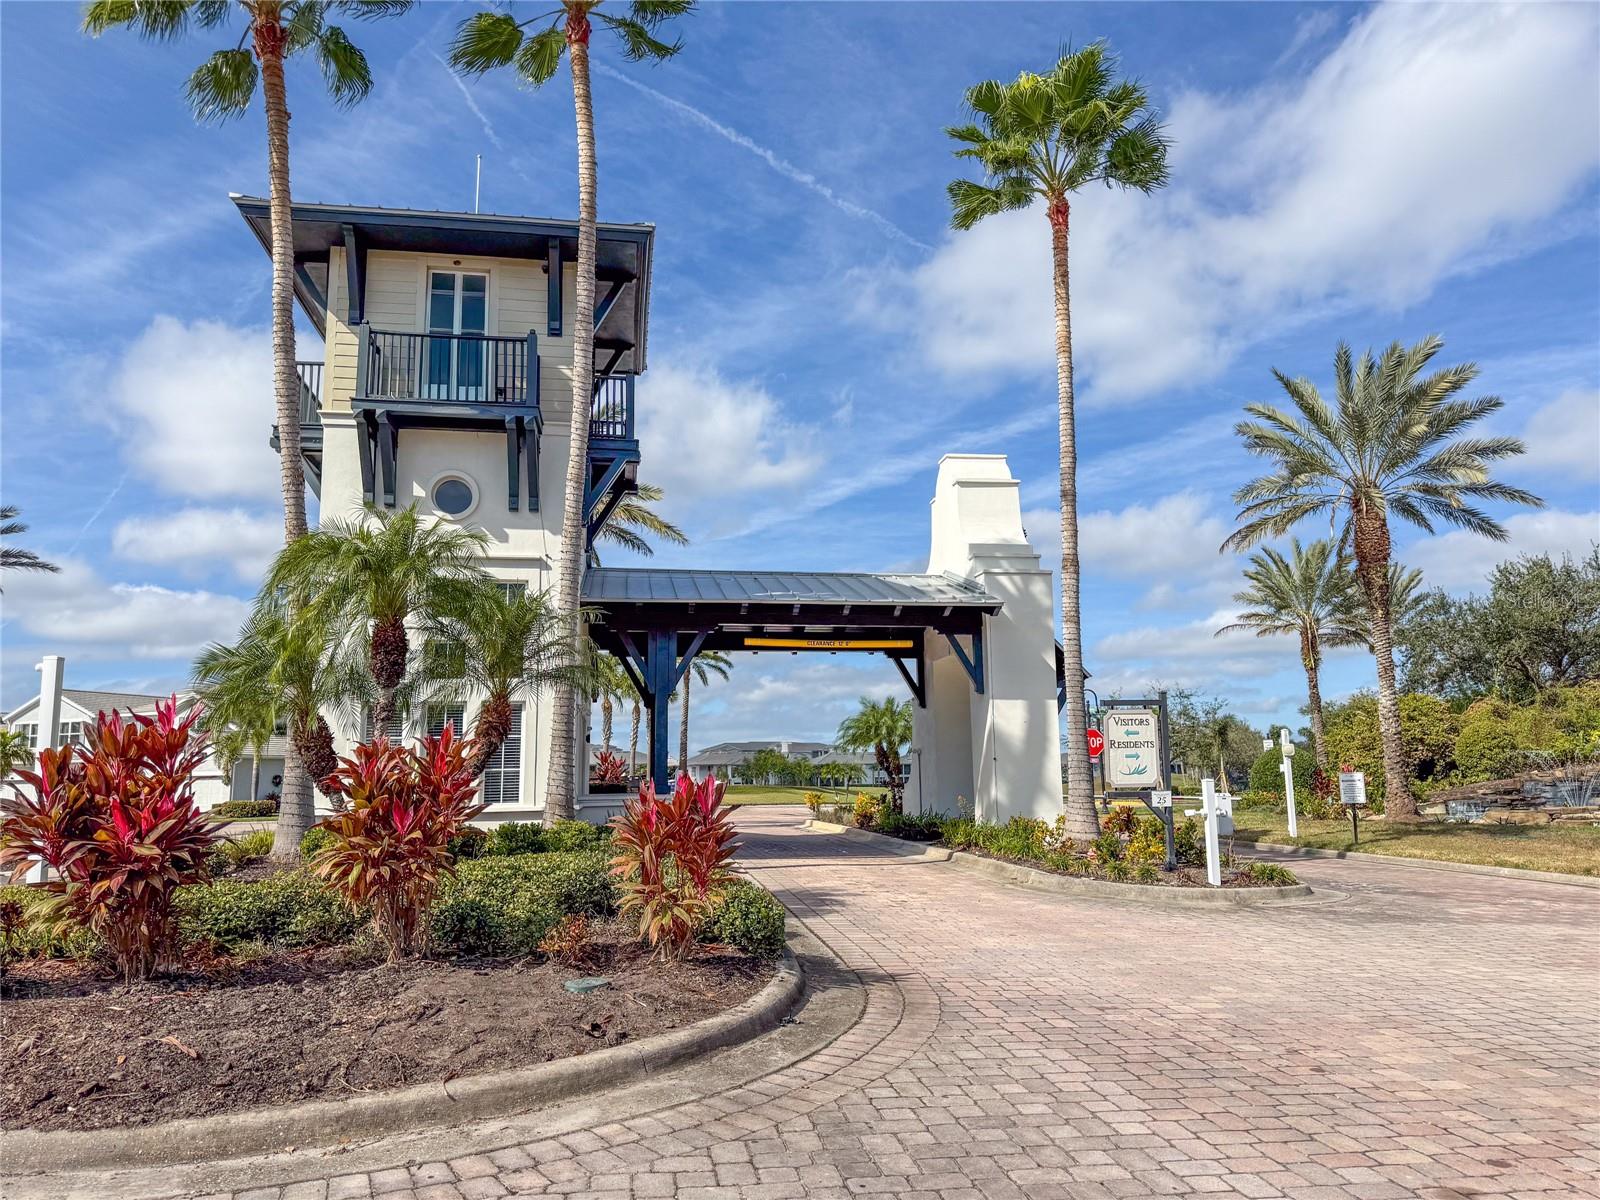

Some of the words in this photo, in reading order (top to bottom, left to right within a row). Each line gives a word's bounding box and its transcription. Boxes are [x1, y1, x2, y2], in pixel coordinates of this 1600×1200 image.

[1113, 717, 1150, 726] VISITORS
[1088, 737, 1103, 748] OP
[1110, 740, 1155, 749] RESIDENTS
